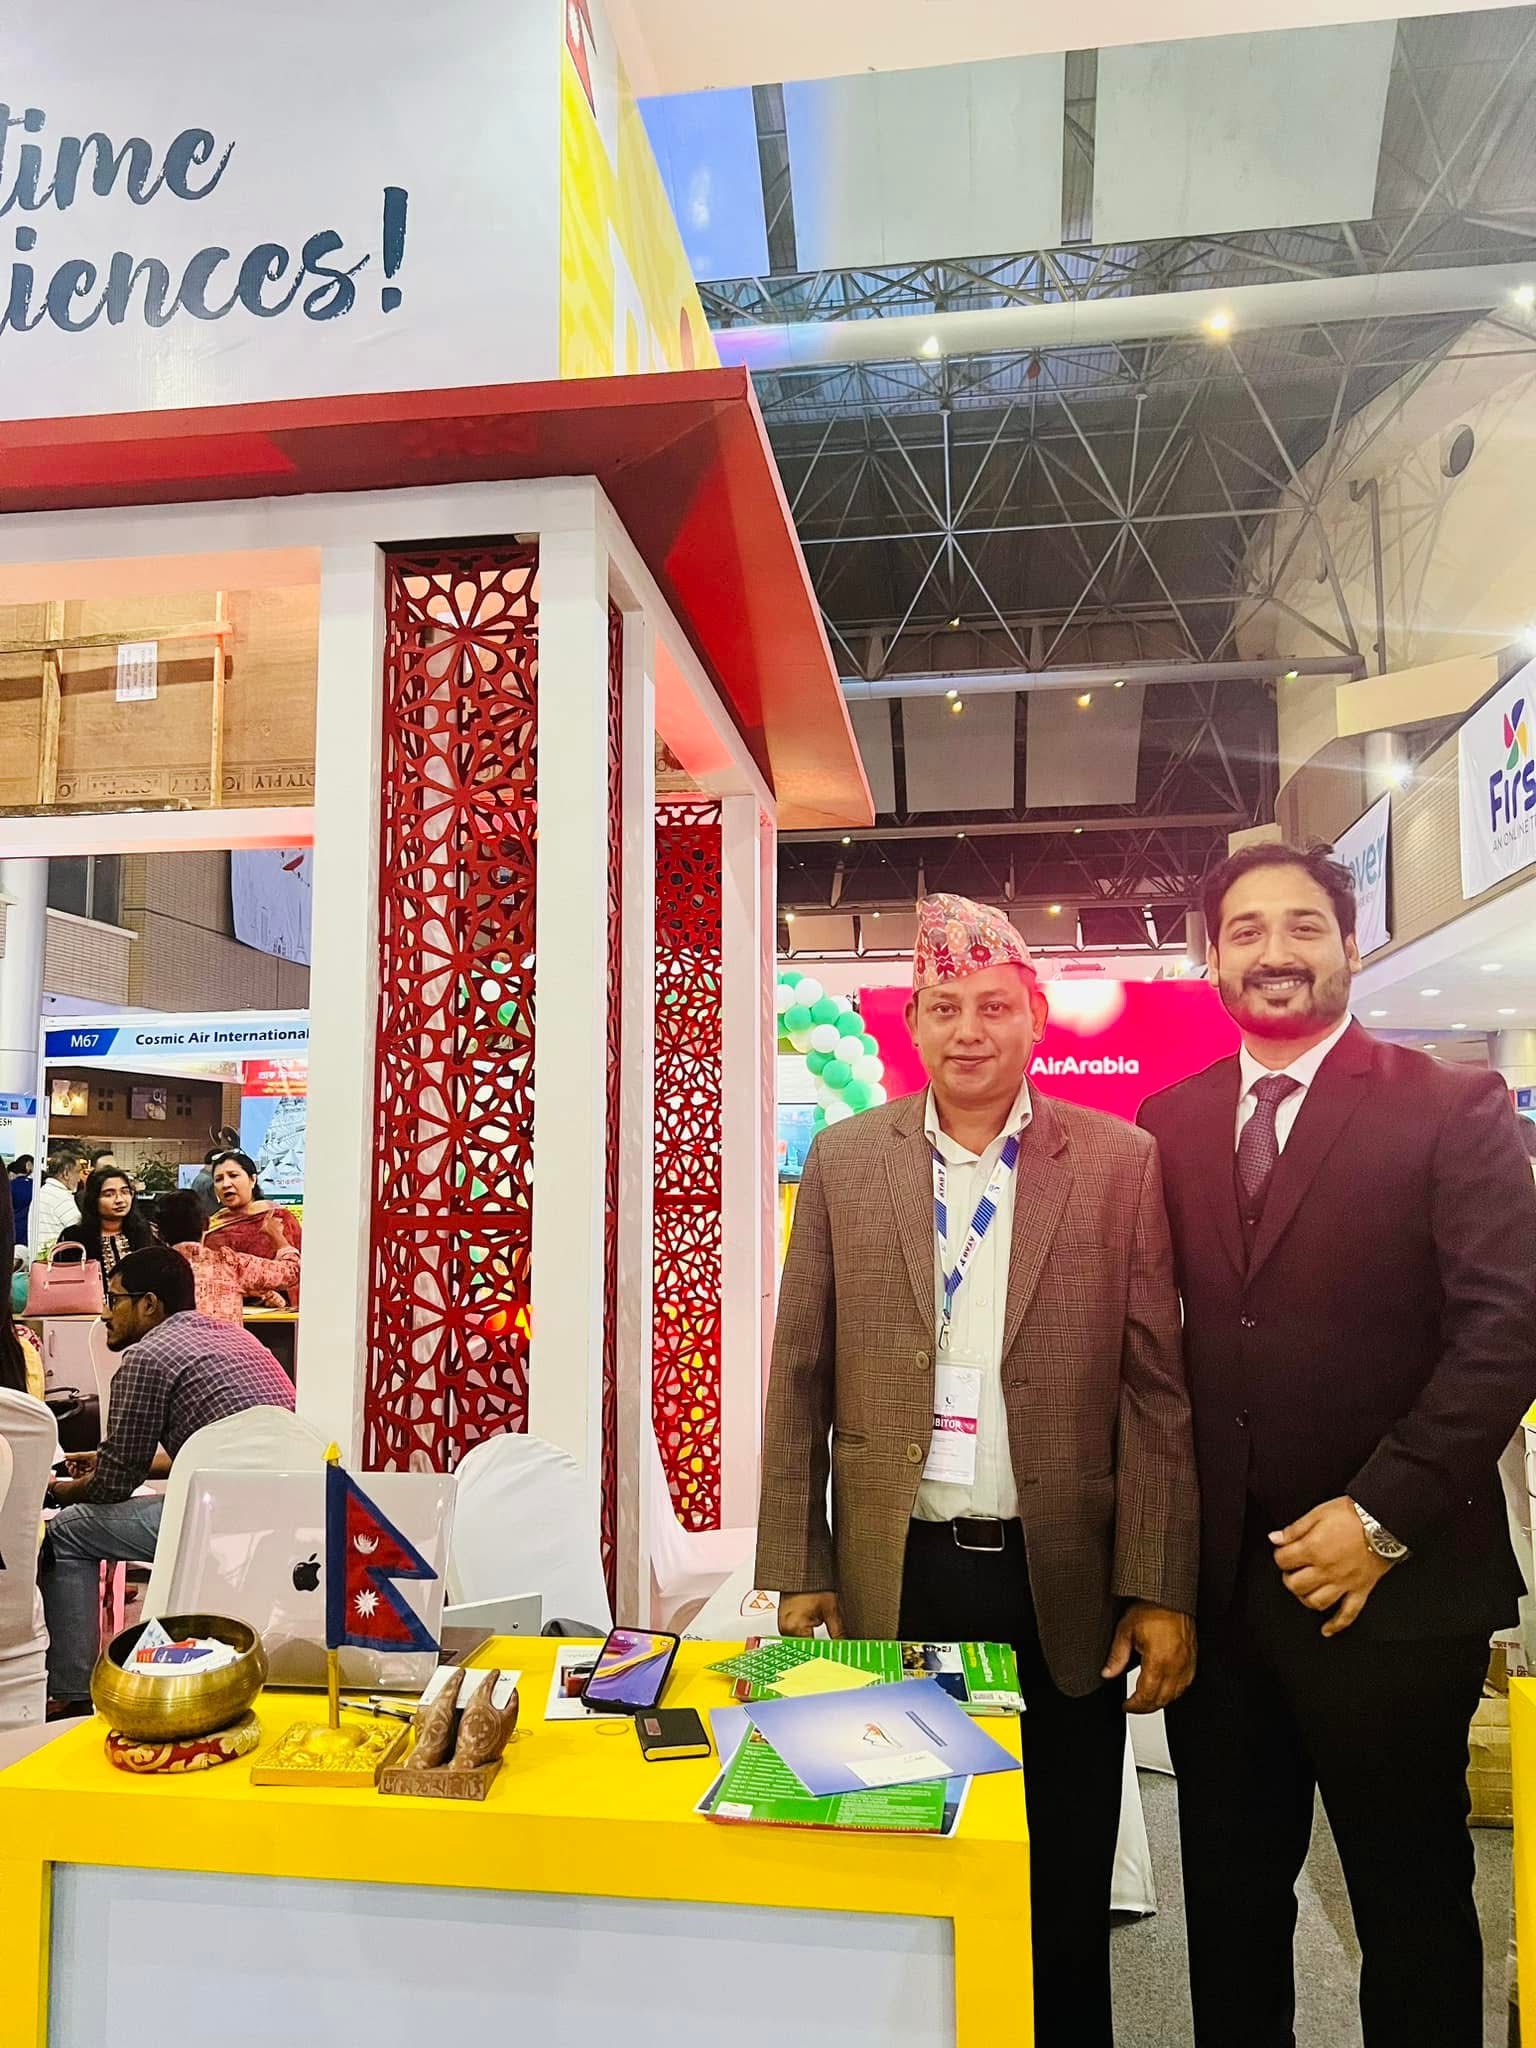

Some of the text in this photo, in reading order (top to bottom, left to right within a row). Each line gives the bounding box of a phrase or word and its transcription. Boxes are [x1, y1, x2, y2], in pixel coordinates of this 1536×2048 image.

[0, 186, 408, 336] iences!
[71, 1034, 99, 1048] M67
[135, 1027, 309, 1046] Cosmic Air International
[1029, 1055, 1140, 1075] AirArabia
